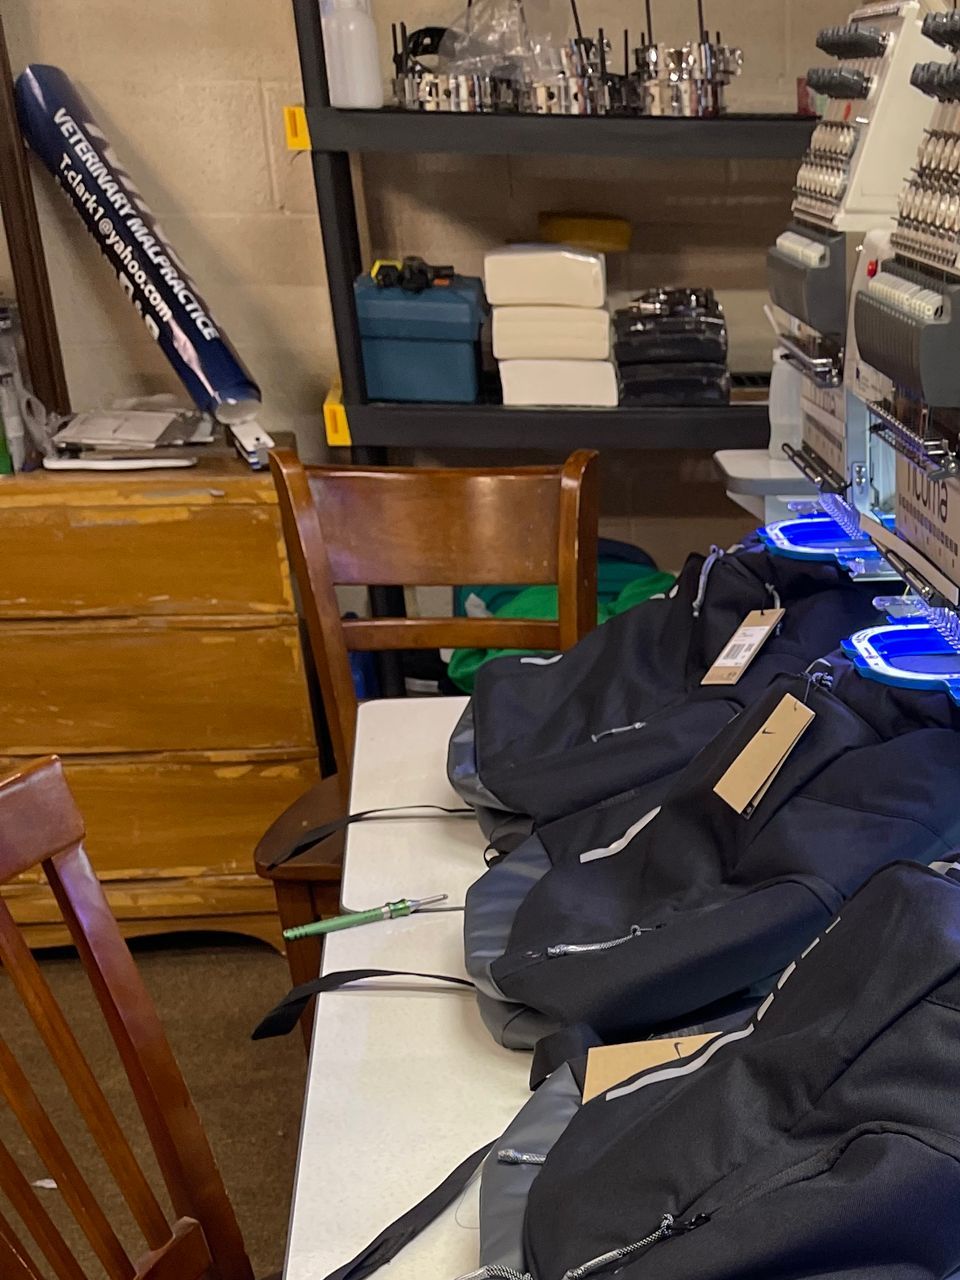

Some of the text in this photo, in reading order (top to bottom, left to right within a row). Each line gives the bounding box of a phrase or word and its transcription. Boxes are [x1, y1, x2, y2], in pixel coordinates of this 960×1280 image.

[53, 107, 137, 219] VETERINARY
[126, 217, 220, 341] MALPRACTICE
[59, 153, 175, 323] T.clark1@yahoo.com
